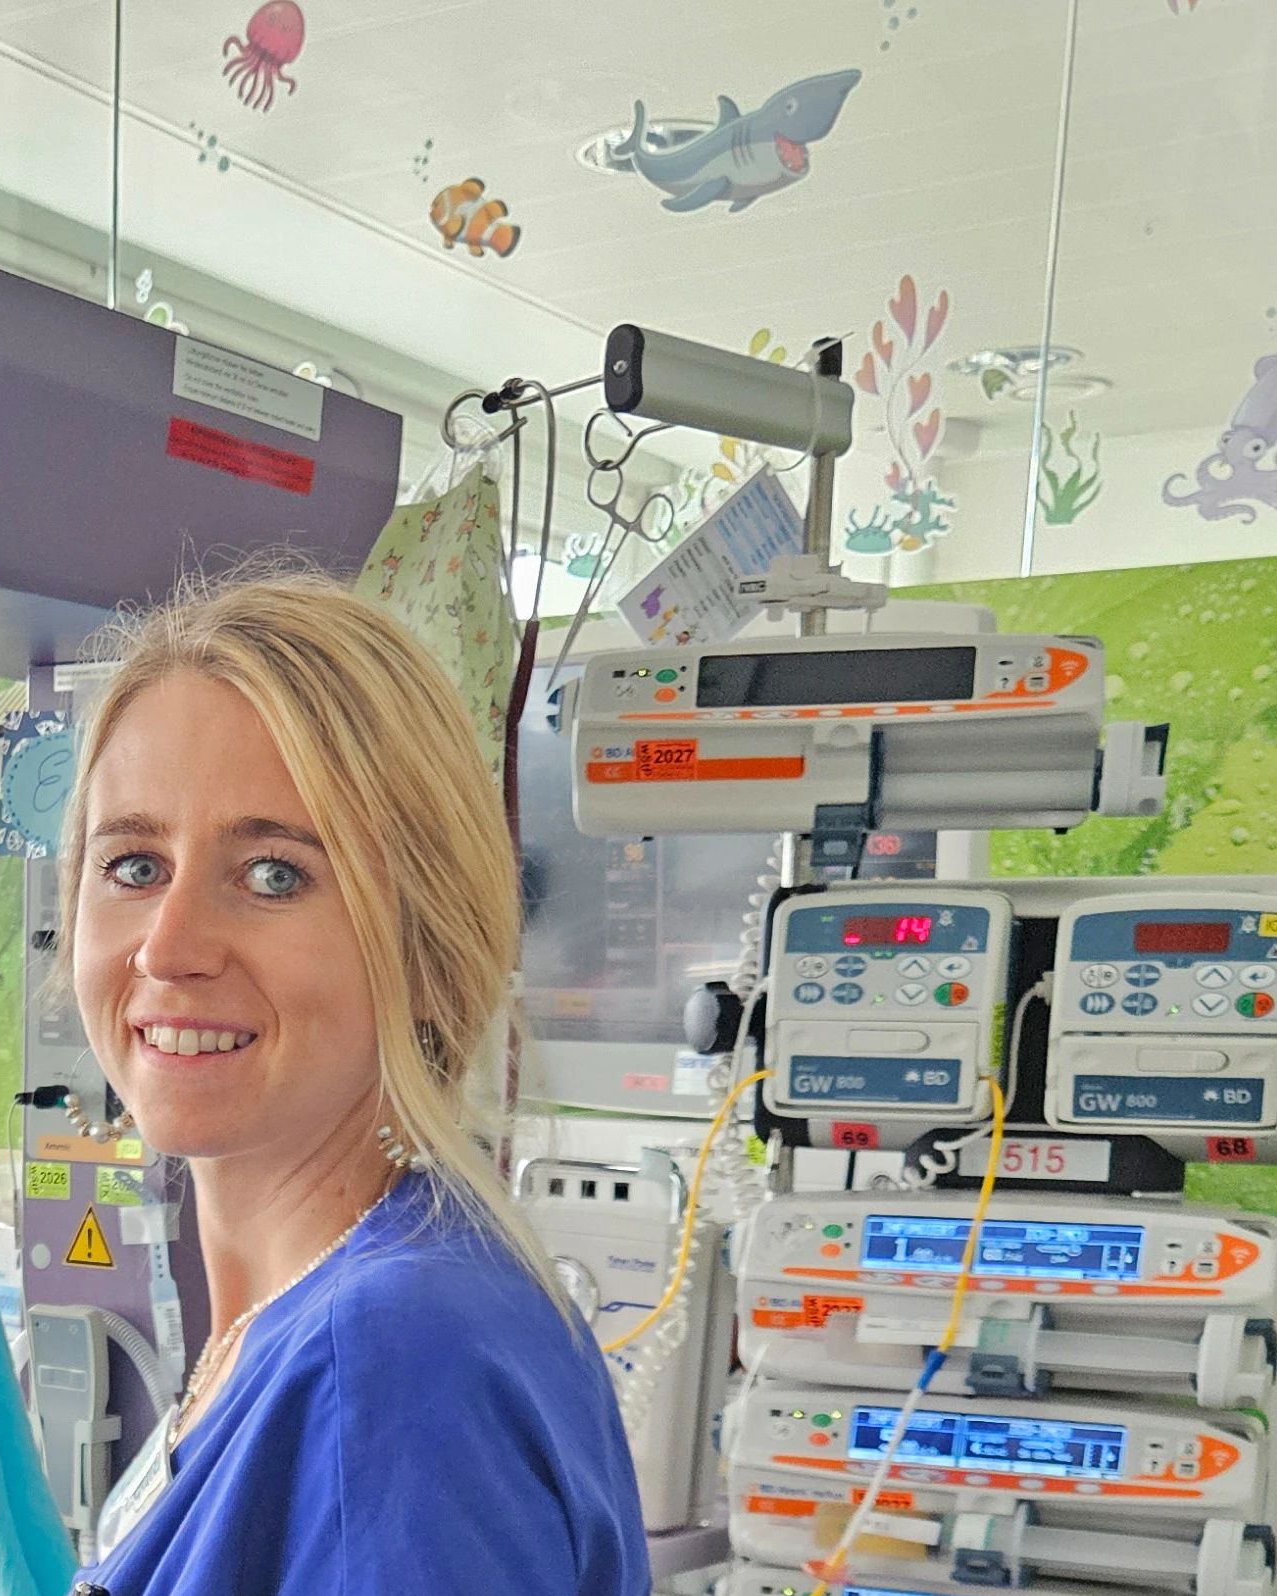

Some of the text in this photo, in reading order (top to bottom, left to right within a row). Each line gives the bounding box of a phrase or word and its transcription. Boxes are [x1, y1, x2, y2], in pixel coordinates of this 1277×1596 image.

[654, 749, 695, 764] 2027
[793, 1074, 834, 1094] GW
[923, 1070, 952, 1087] BD
[1078, 1092, 1123, 1112] GW
[1223, 1088, 1253, 1105] BD
[840, 1130, 870, 1146] 69
[1216, 1137, 1249, 1156] 68
[1003, 1143, 1066, 1174] 515
[39, 1171, 68, 1186] 2026
